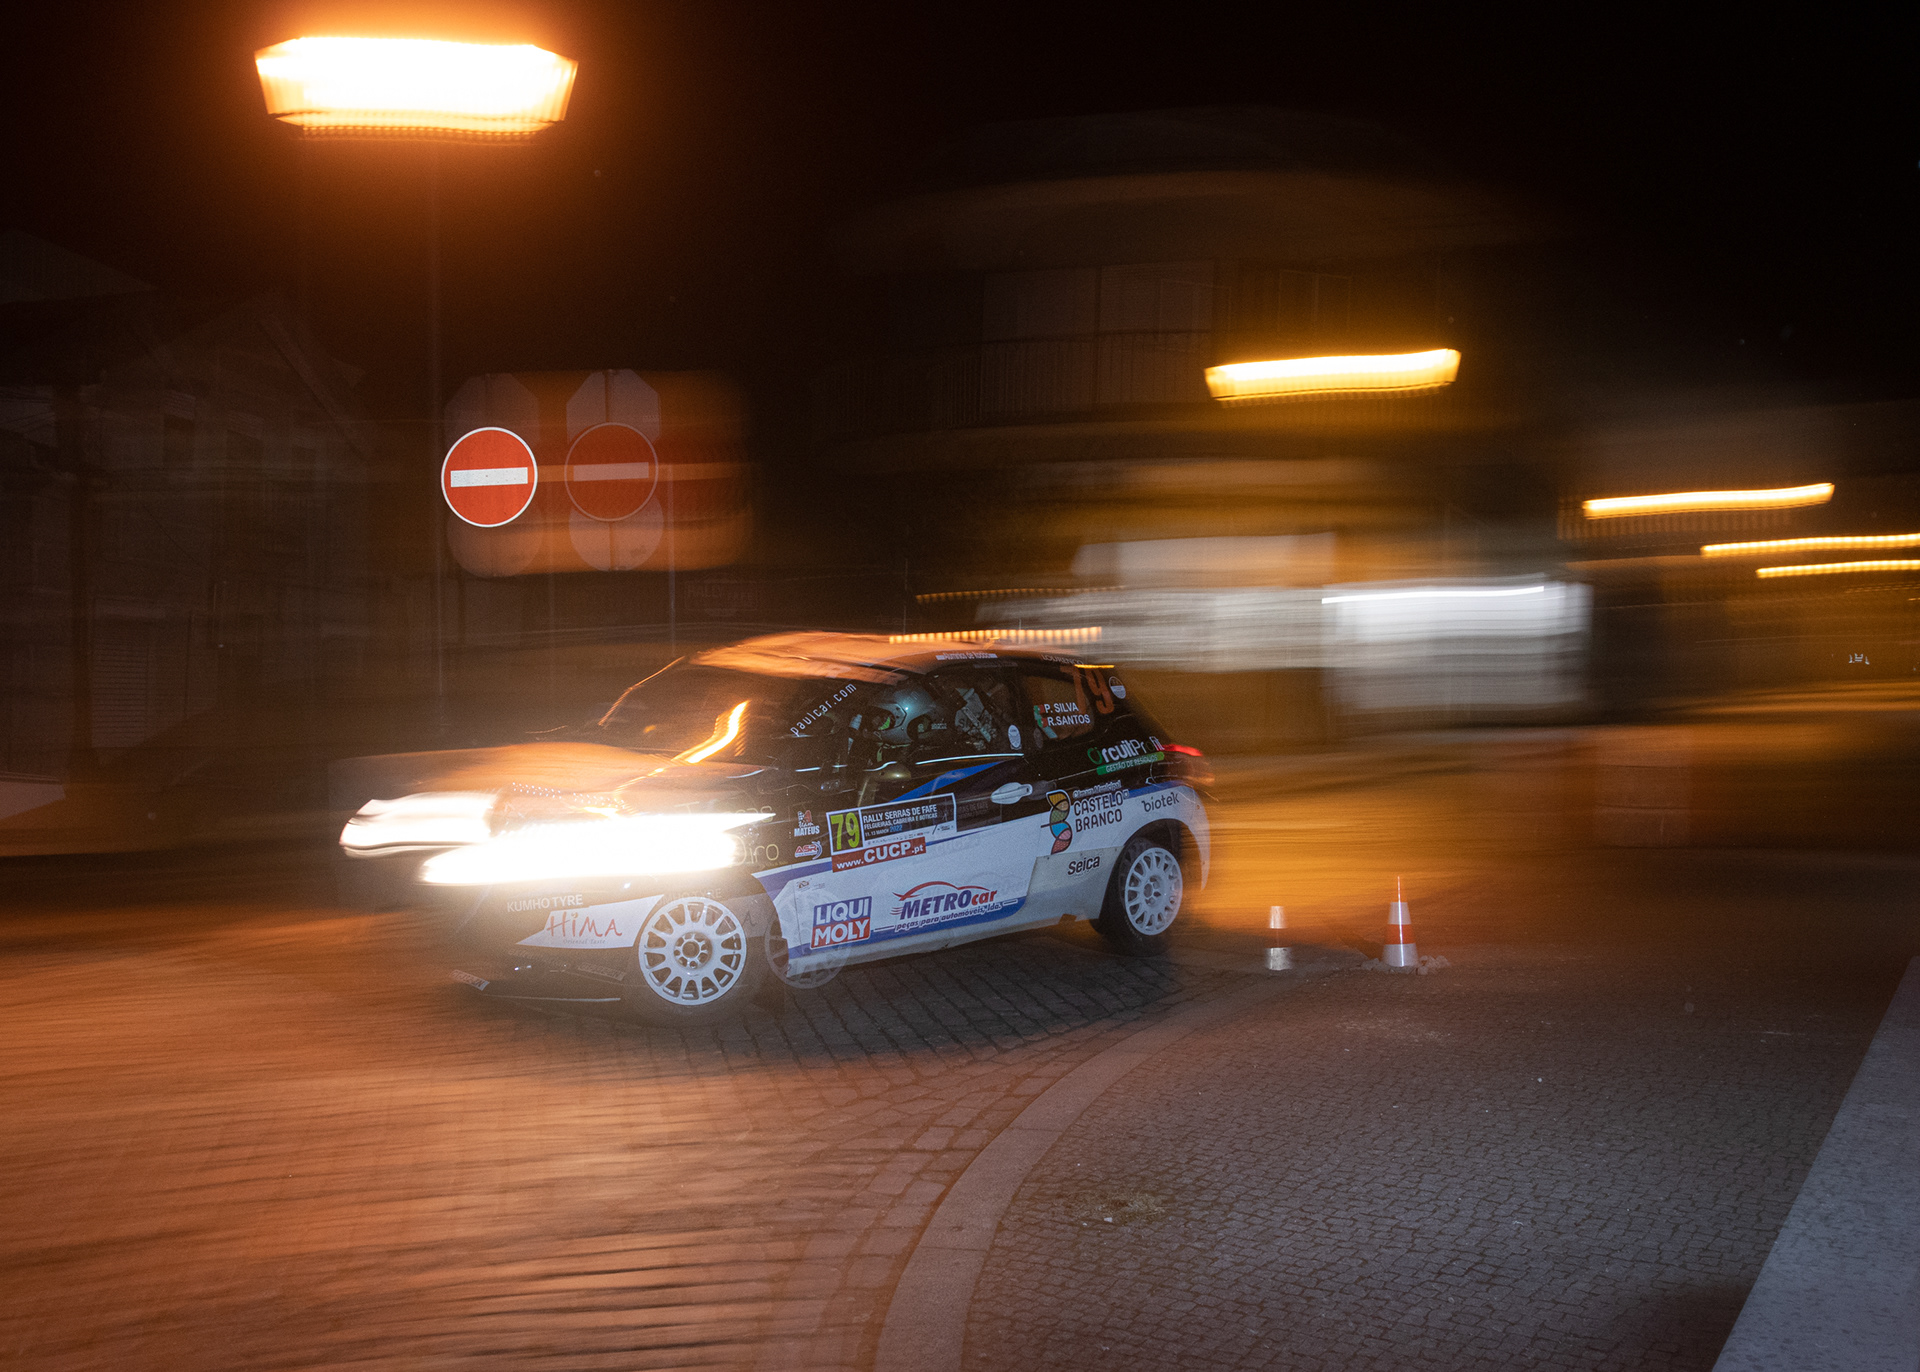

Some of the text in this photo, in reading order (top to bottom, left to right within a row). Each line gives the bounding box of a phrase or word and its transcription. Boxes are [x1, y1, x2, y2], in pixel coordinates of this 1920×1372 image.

[1060, 665, 1114, 714] 79
[790, 683, 857, 737] paulcar.com
[1044, 702, 1079, 714] P. SILVA
[1047, 714, 1090, 726] R.SANTOS
[1126, 760, 1134, 768] DE
[1073, 793, 1124, 816] CASTELO
[1141, 792, 1180, 813] biotek
[863, 804, 937, 824] RALLY SERRAS DE FAFE
[1075, 808, 1123, 832] BRANCO
[794, 825, 820, 837] MATEUS
[830, 812, 860, 850] 79
[863, 820, 894, 830] FELGUEIRAS,
[836, 842, 924, 869] www.CUCP.pt
[1067, 856, 1101, 875] Seica
[506, 894, 583, 913] KUMHO TYRE
[815, 898, 869, 925] LIQUI
[900, 889, 998, 920] METROcar
[921, 917, 940, 926] para
[813, 919, 870, 947] MOLY
